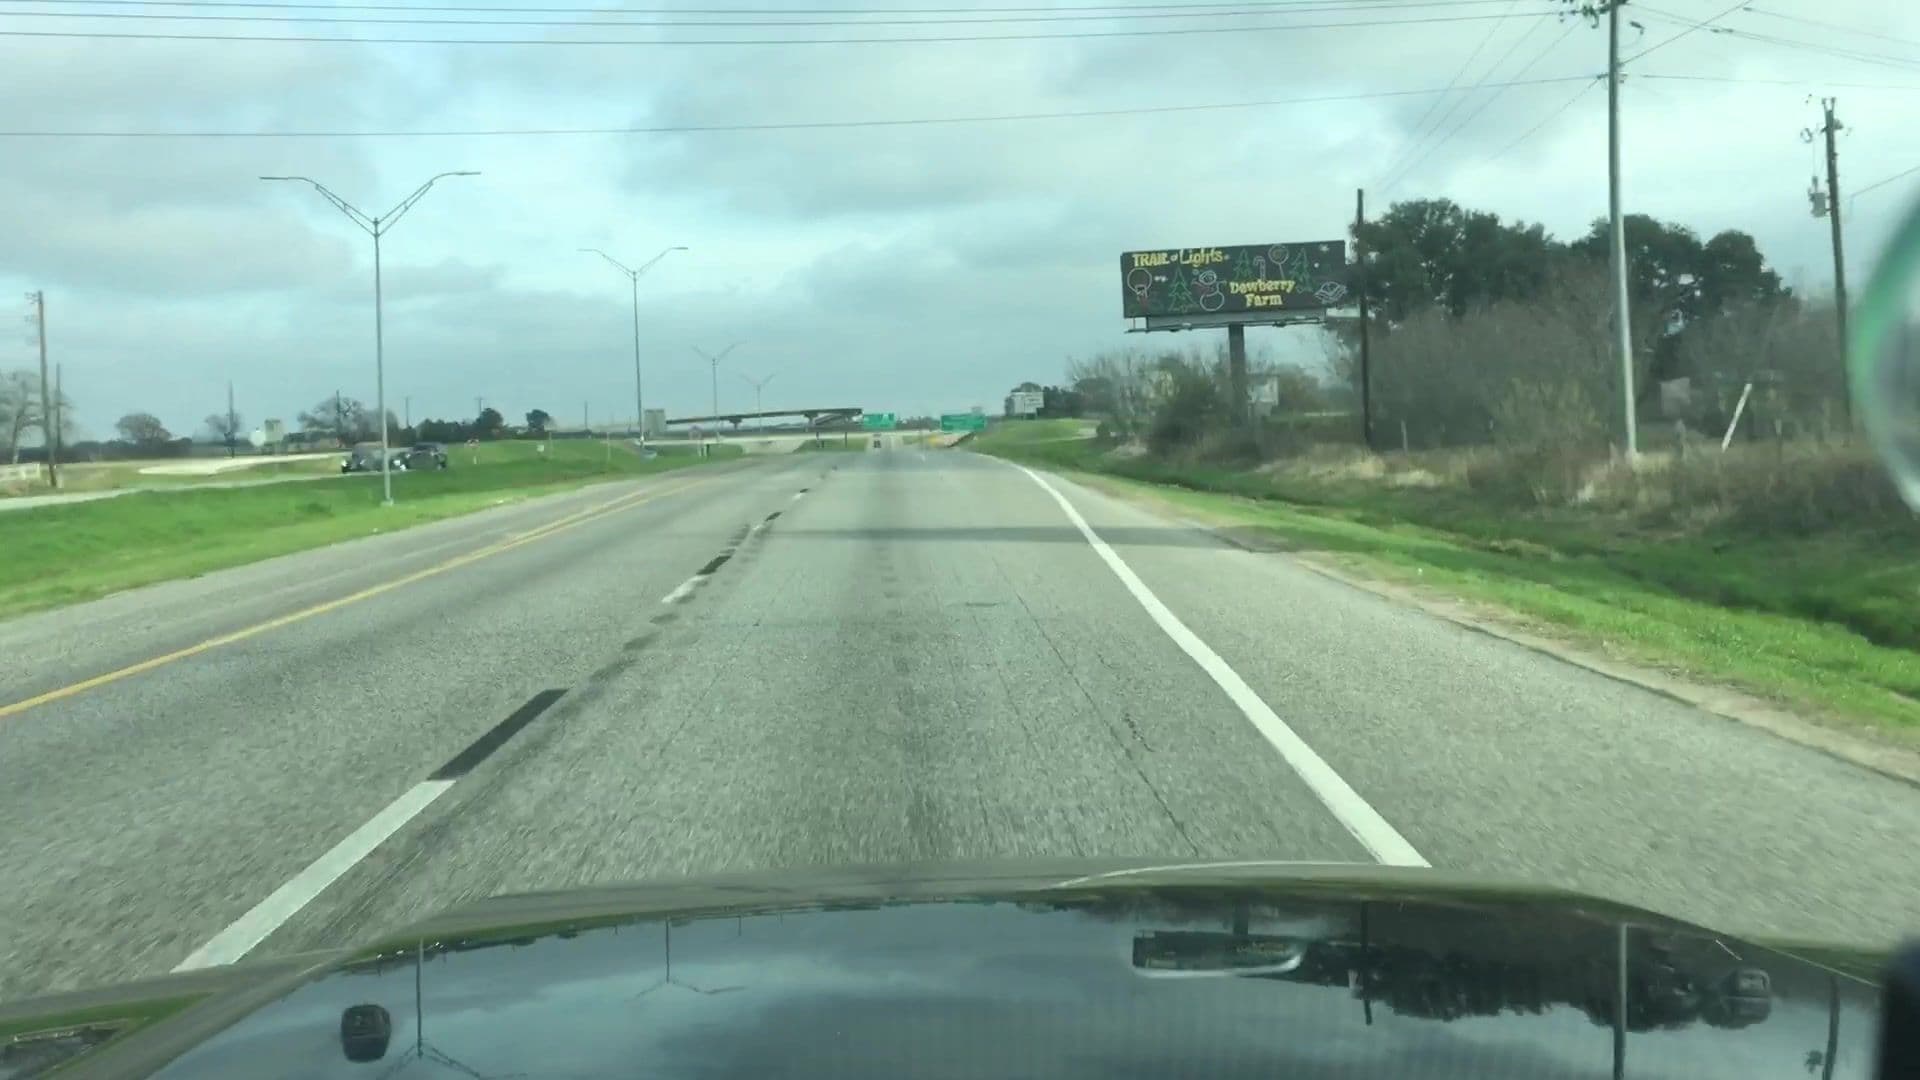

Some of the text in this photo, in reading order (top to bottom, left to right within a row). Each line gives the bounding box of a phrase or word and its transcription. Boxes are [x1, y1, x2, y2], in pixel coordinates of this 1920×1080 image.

[1132, 252, 1170, 267] TRAIL
[1179, 248, 1223, 267] Lights
[1229, 279, 1296, 294] Dewberry
[1245, 293, 1283, 307] Farm
